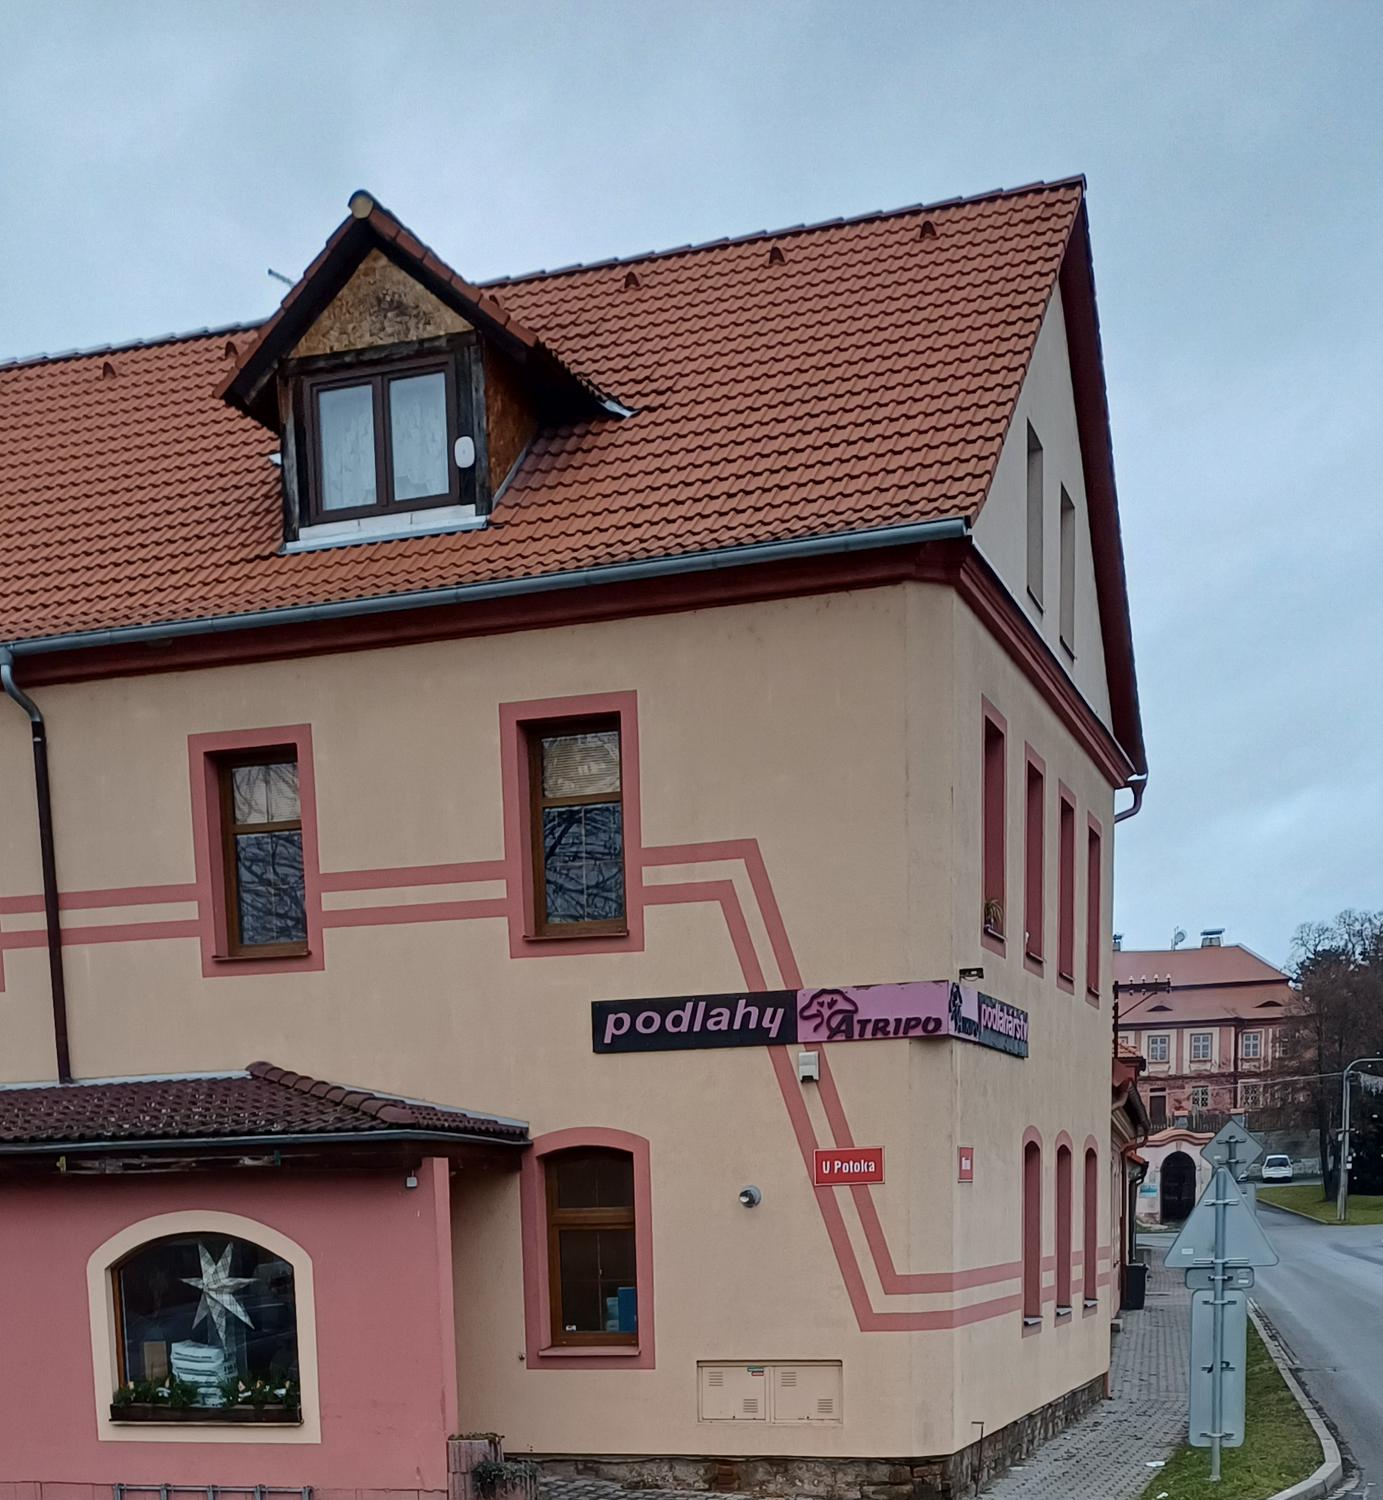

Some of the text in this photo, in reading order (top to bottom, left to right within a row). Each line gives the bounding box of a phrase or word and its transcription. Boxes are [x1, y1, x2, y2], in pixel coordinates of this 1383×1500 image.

[603, 999, 784, 1044] podlahy
[822, 1159, 875, 1174] U Potoka
